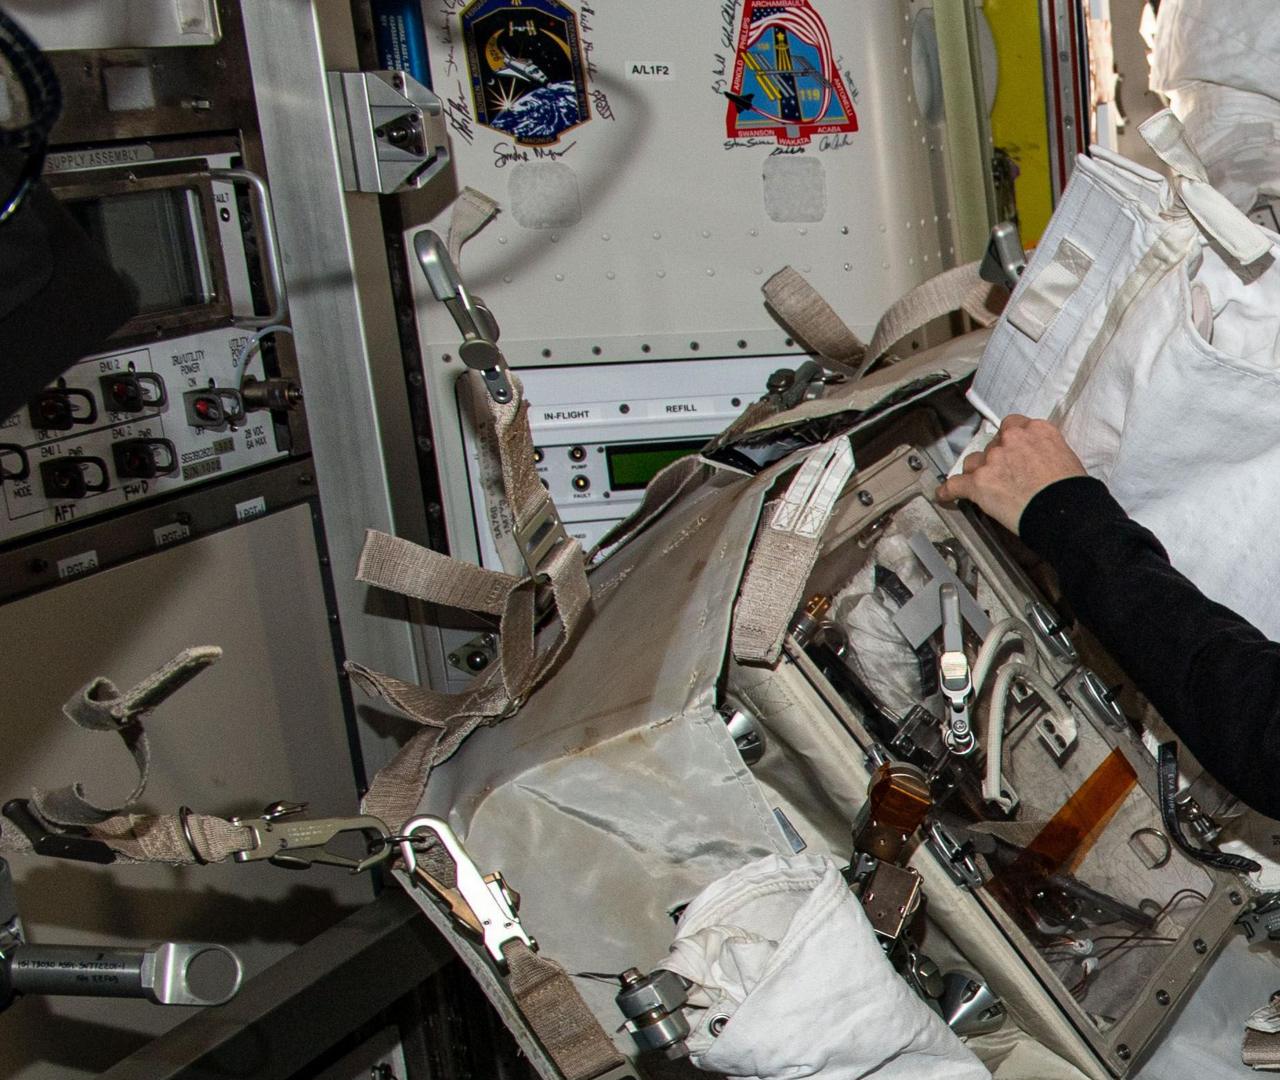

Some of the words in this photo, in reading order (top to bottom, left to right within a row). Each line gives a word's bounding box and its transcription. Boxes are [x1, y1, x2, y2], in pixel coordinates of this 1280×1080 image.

[739, 17, 751, 50] PHILLIPS
[631, 63, 670, 76] A/L1F2
[733, 60, 744, 91] ARNOLD
[799, 89, 821, 101] 119
[834, 78, 854, 117] ANTONELLI
[737, 129, 775, 138] SWANSON
[817, 126, 842, 134] ACABA
[778, 137, 810, 146] WAKATA
[47, 153, 85, 169] SUPPLY
[88, 149, 139, 165] ASSEMBLY
[543, 410, 590, 421] IN-FLIGHT
[665, 404, 698, 414] REFILL
[54, 503, 77, 524] AFT
[123, 481, 149, 502] FWD
[573, 492, 592, 500] FAULT
[1167, 772, 1176, 791] EVA
